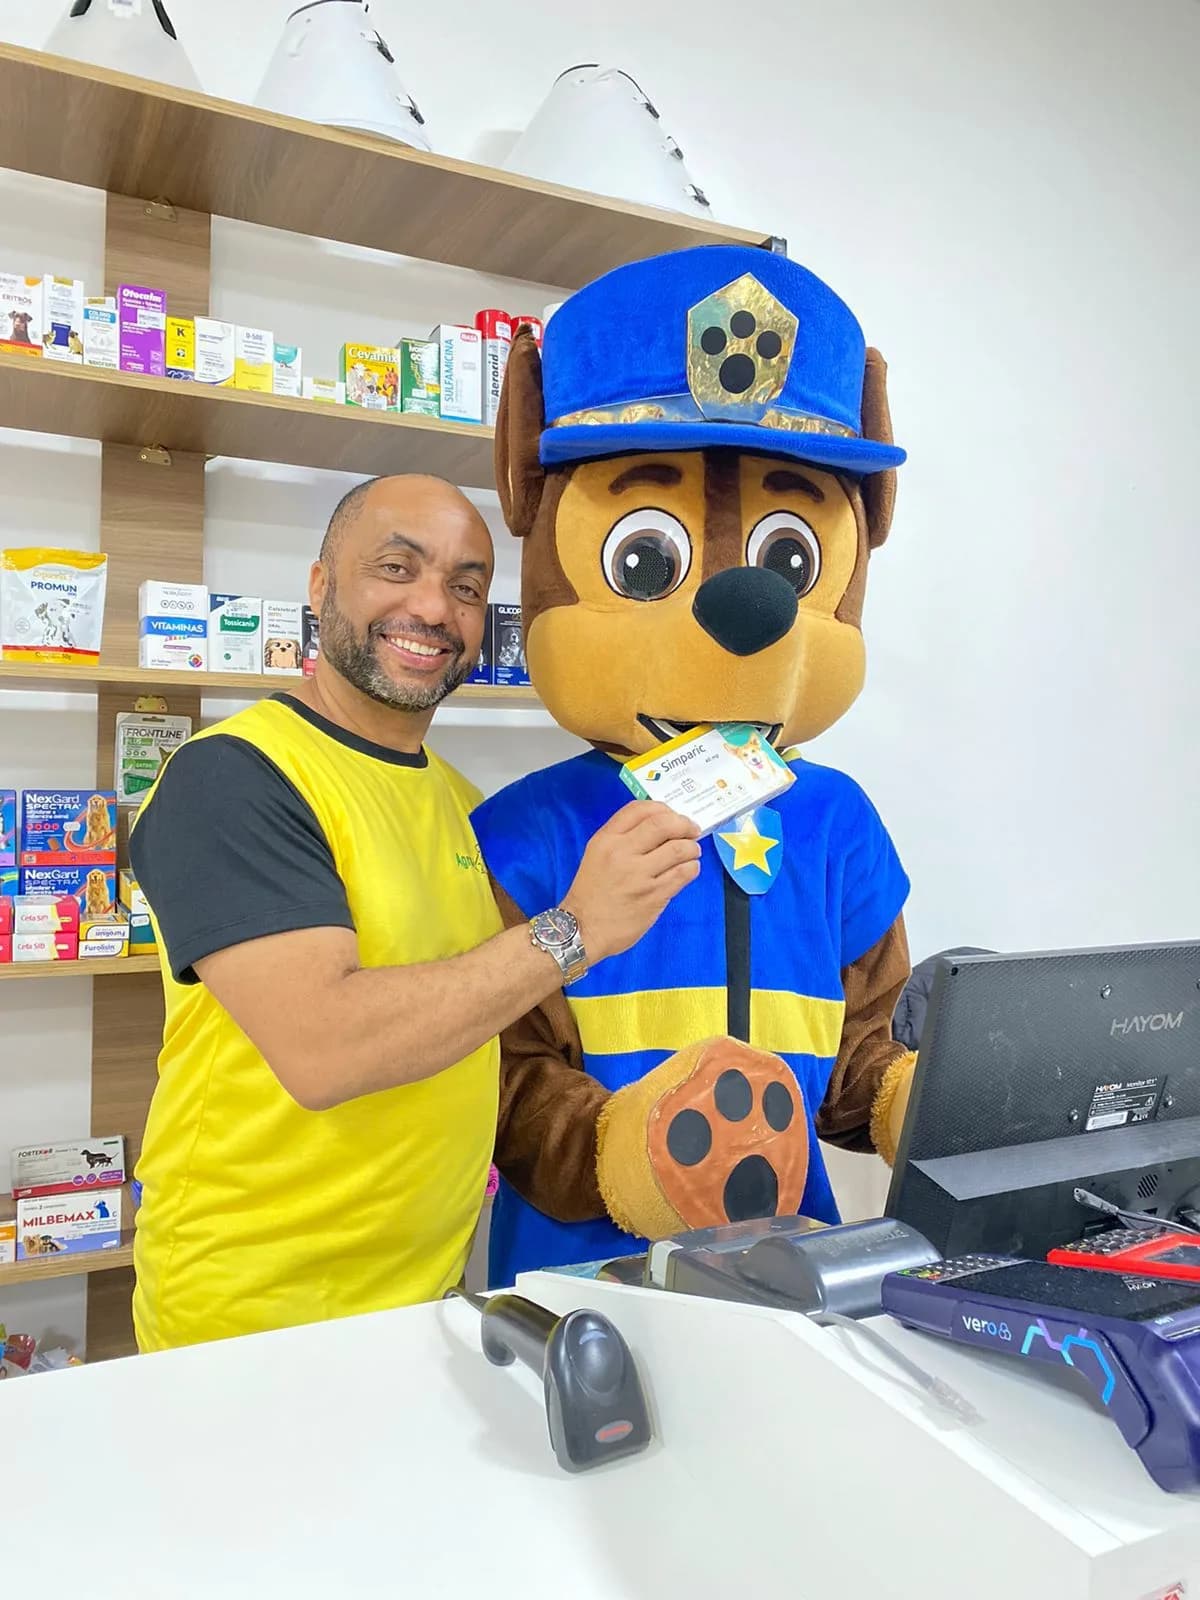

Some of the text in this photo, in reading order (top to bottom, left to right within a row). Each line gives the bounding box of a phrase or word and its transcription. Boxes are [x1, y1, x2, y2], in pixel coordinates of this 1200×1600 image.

[177, 328, 185, 337] K
[349, 347, 399, 363] Cevamix
[444, 339, 454, 402] SULFAMICINA
[488, 354, 499, 398] Aerocid
[31, 581, 77, 593] PROMUN
[151, 621, 204, 633] VITAMINAS
[223, 619, 255, 628] Tossicanis
[126, 728, 183, 739] FRONTLINE
[661, 743, 706, 773] Simparic
[26, 794, 80, 804] NexGard
[25, 870, 79, 879] NexGard
[1110, 1012, 1184, 1036] HAYOM
[23, 1210, 95, 1228] MILBEMAX
[962, 1315, 998, 1336] vero
